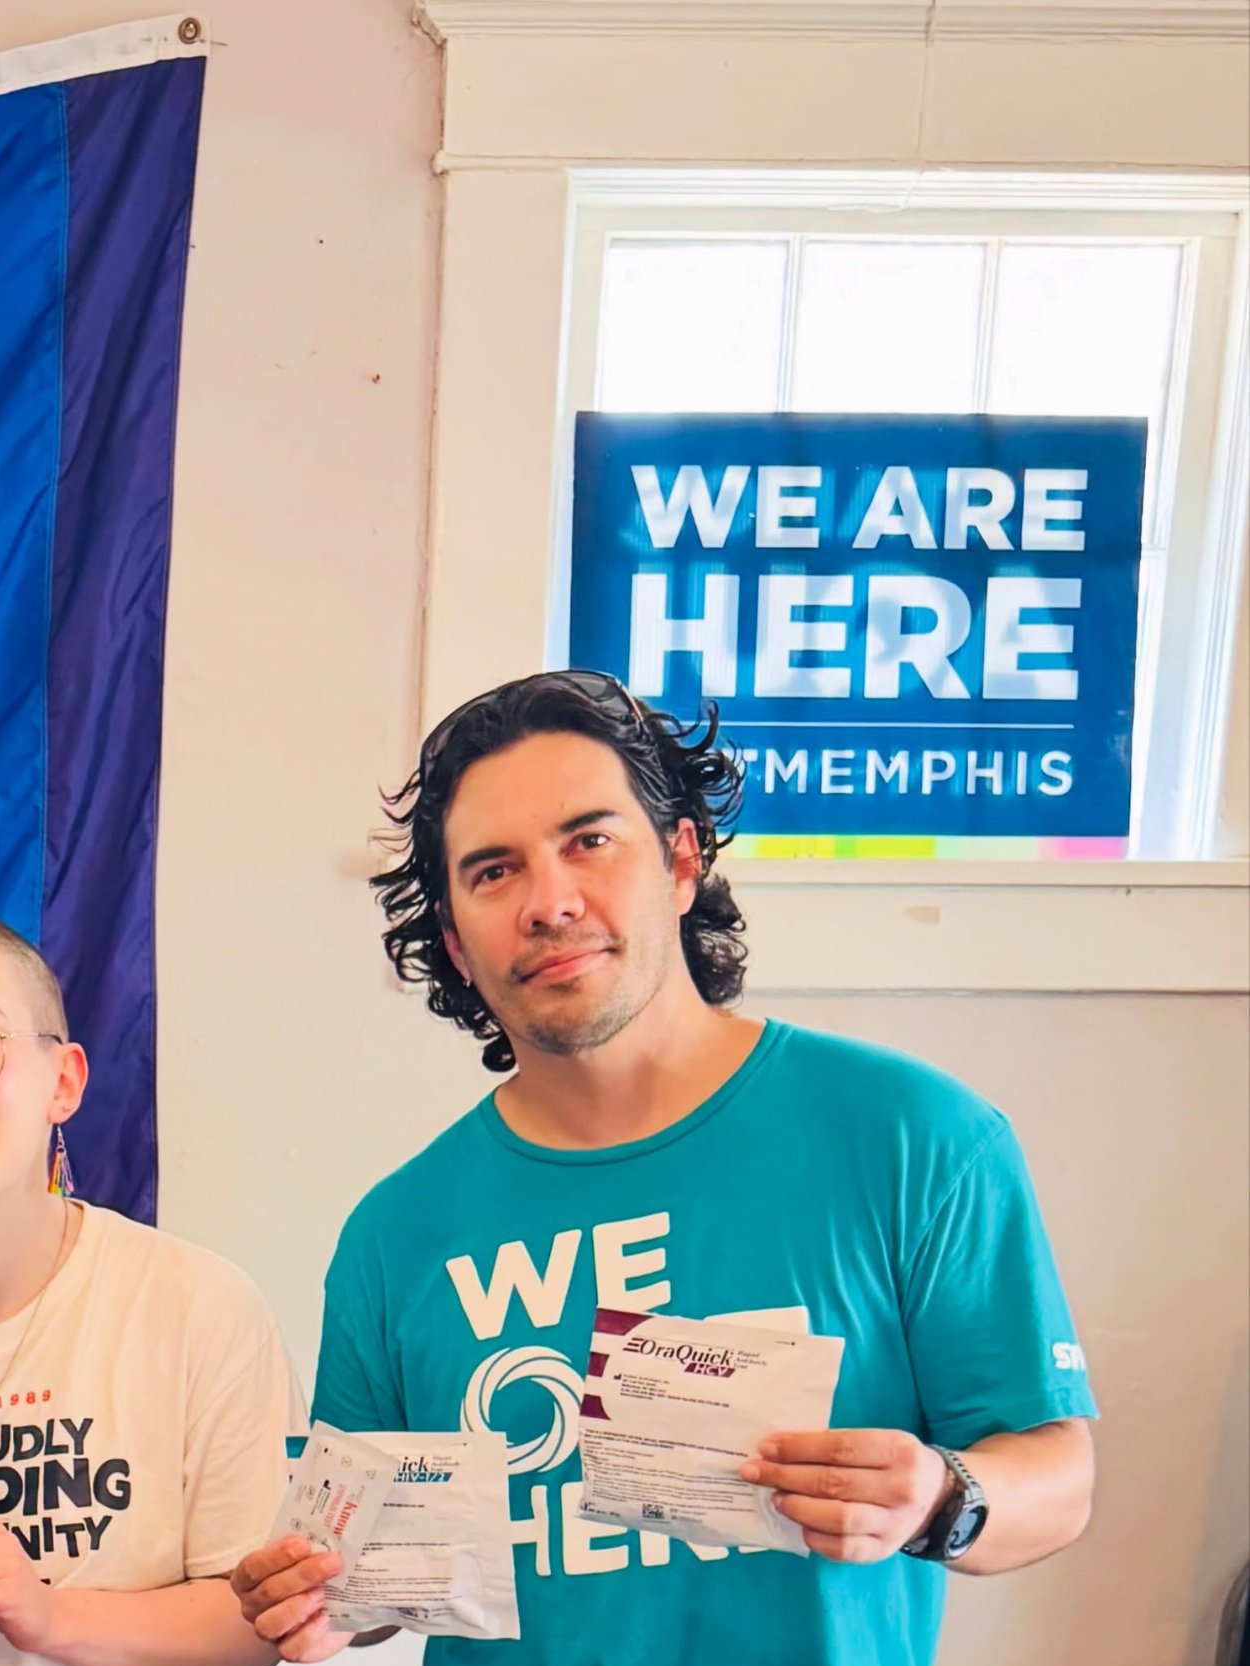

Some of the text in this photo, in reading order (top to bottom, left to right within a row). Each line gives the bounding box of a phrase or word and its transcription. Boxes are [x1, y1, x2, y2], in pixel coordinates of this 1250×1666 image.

[631, 465, 1088, 551] WE ARE
[627, 573, 1083, 700] HERE
[445, 1211, 671, 1341] WE
[638, 1339, 732, 1365] OraQuick
[693, 1363, 729, 1377] HCV
